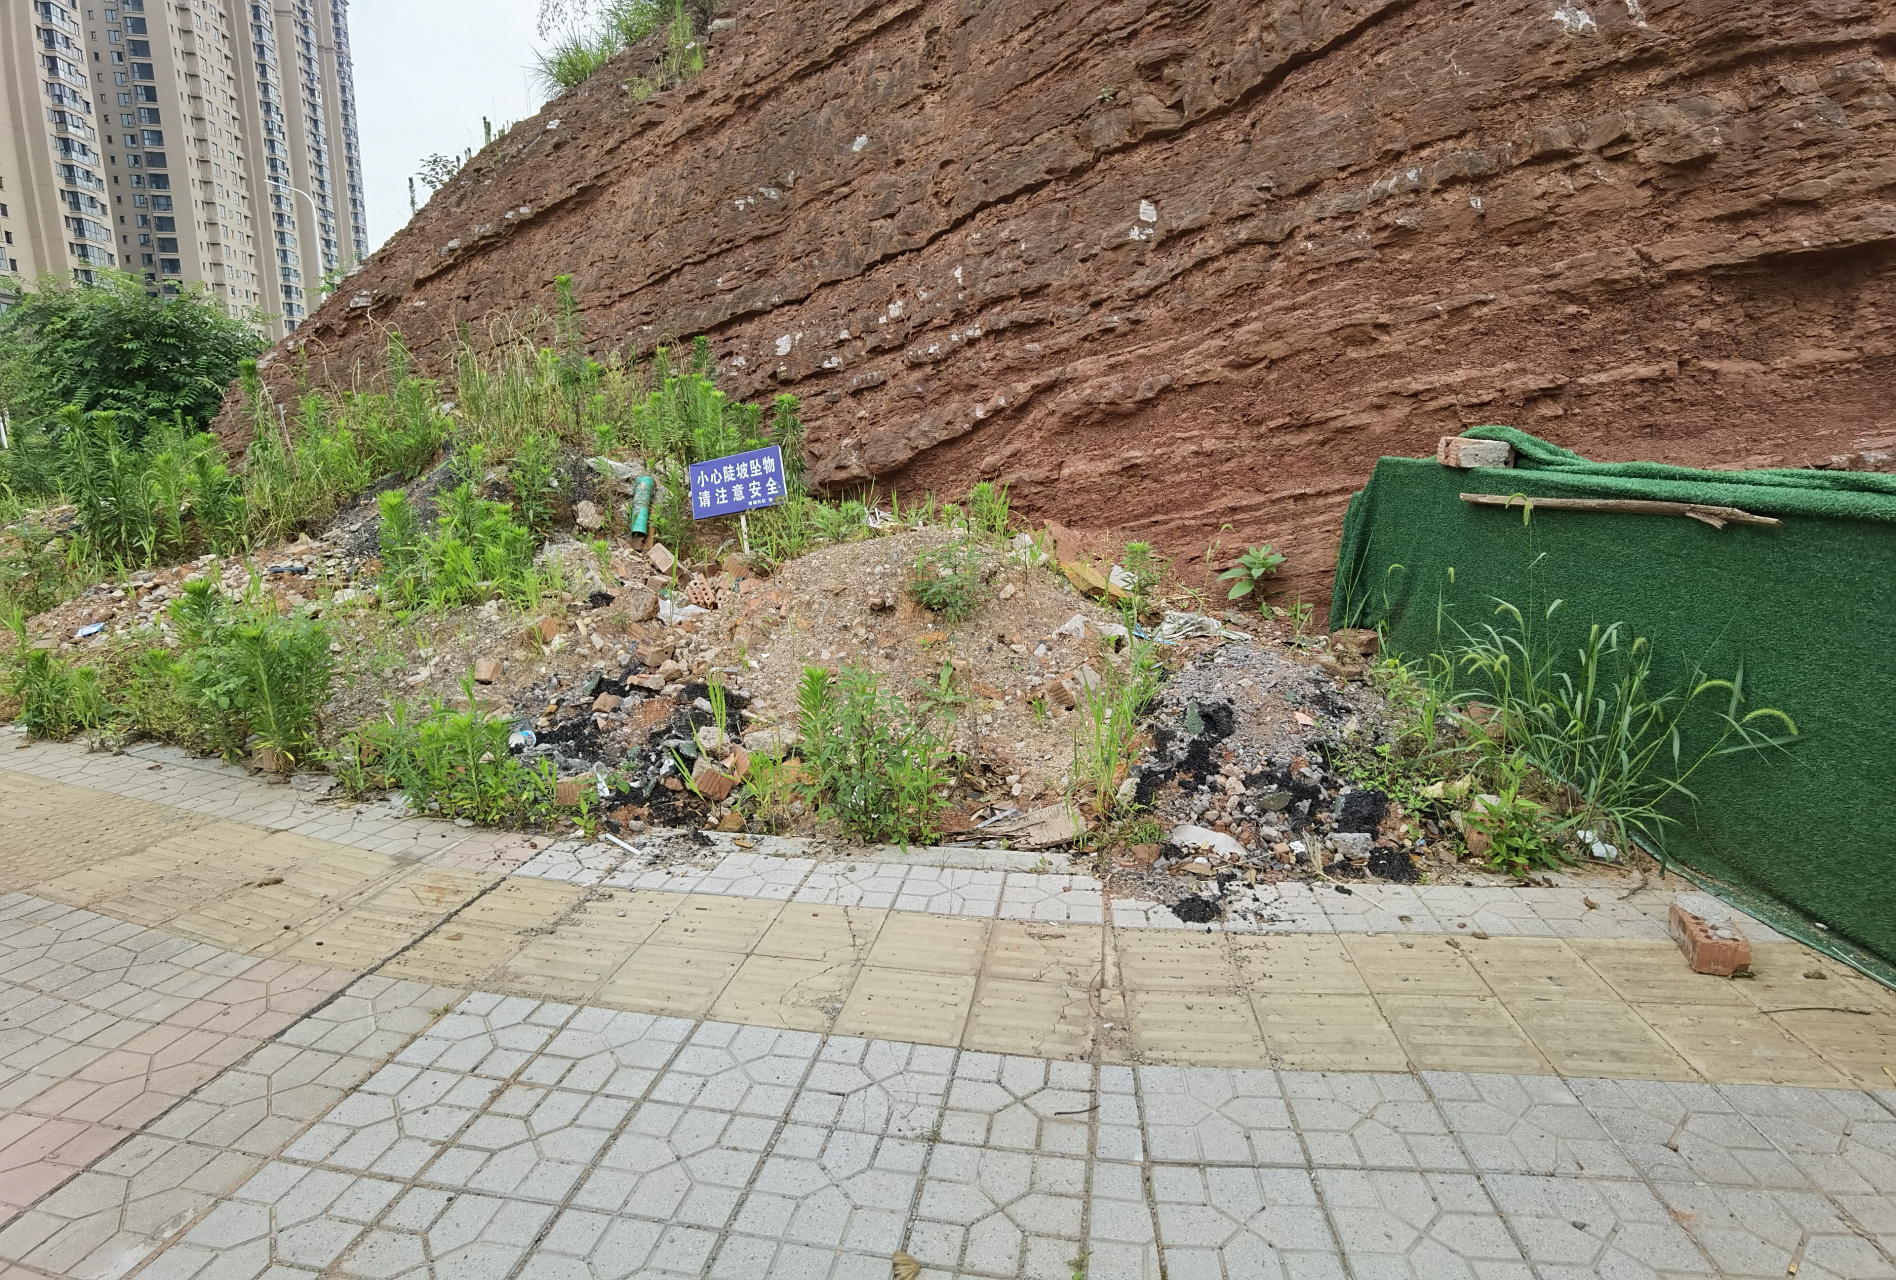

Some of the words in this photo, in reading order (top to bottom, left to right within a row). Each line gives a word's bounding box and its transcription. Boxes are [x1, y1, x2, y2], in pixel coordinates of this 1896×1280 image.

[697, 456, 775, 487] 小心陡坡坠物
[698, 477, 778, 507] 请注意安全
